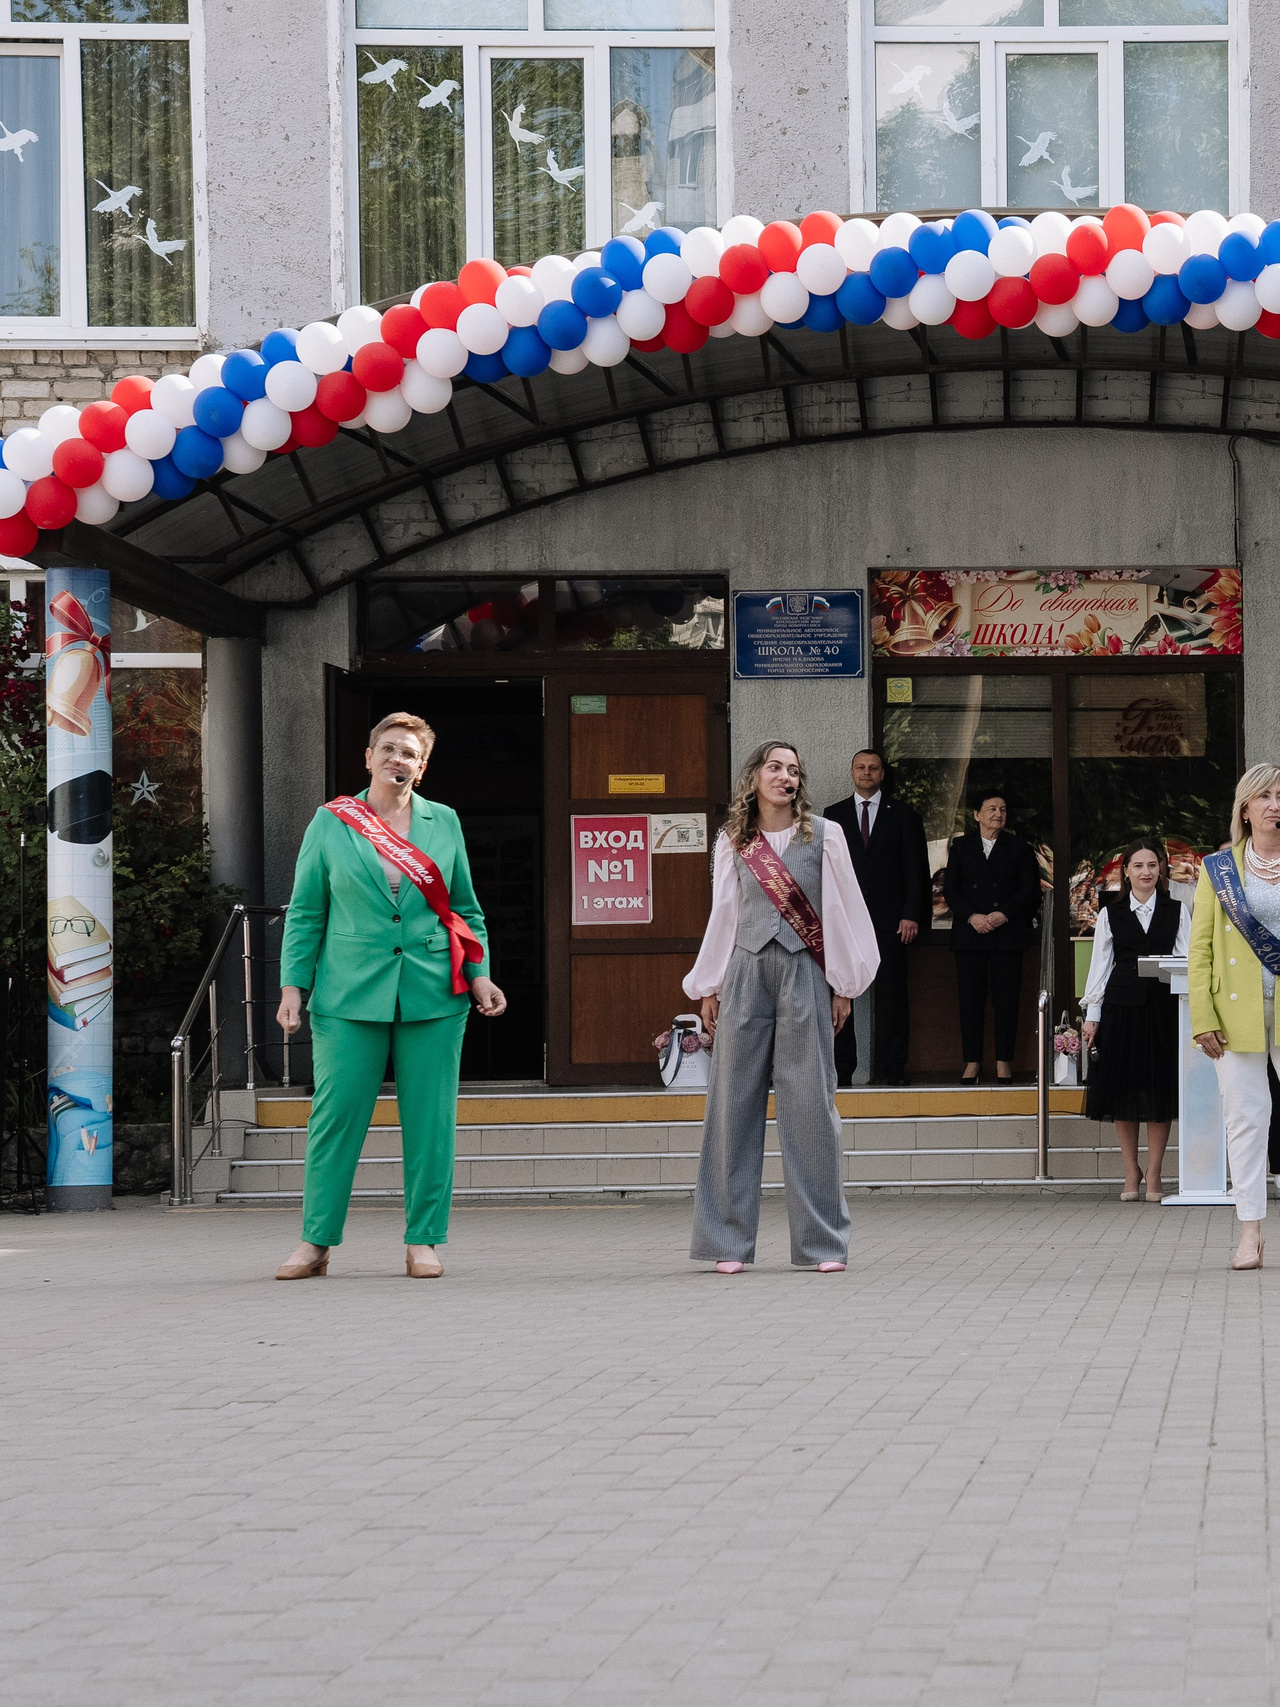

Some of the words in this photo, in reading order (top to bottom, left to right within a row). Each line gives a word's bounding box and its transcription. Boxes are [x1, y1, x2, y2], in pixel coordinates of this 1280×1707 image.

[973, 584, 1025, 617] До
[1039, 590, 1139, 622] свидания,
[758, 647, 803, 656] ШКОЛА
[809, 646, 821, 655] №
[824, 646, 839, 655] 40
[972, 623, 1065, 645] ШКОЛА!
[326, 797, 382, 838] Классный
[579, 830, 644, 850] ВХОД
[588, 859, 634, 882] №1
[760, 853, 792, 895] Классный
[1217, 854, 1238, 908] Классный
[582, 895, 588, 909] 1
[592, 897, 644, 909] этаж
[762, 879, 806, 928] руководитель
[1216, 889, 1257, 949] руководитель
